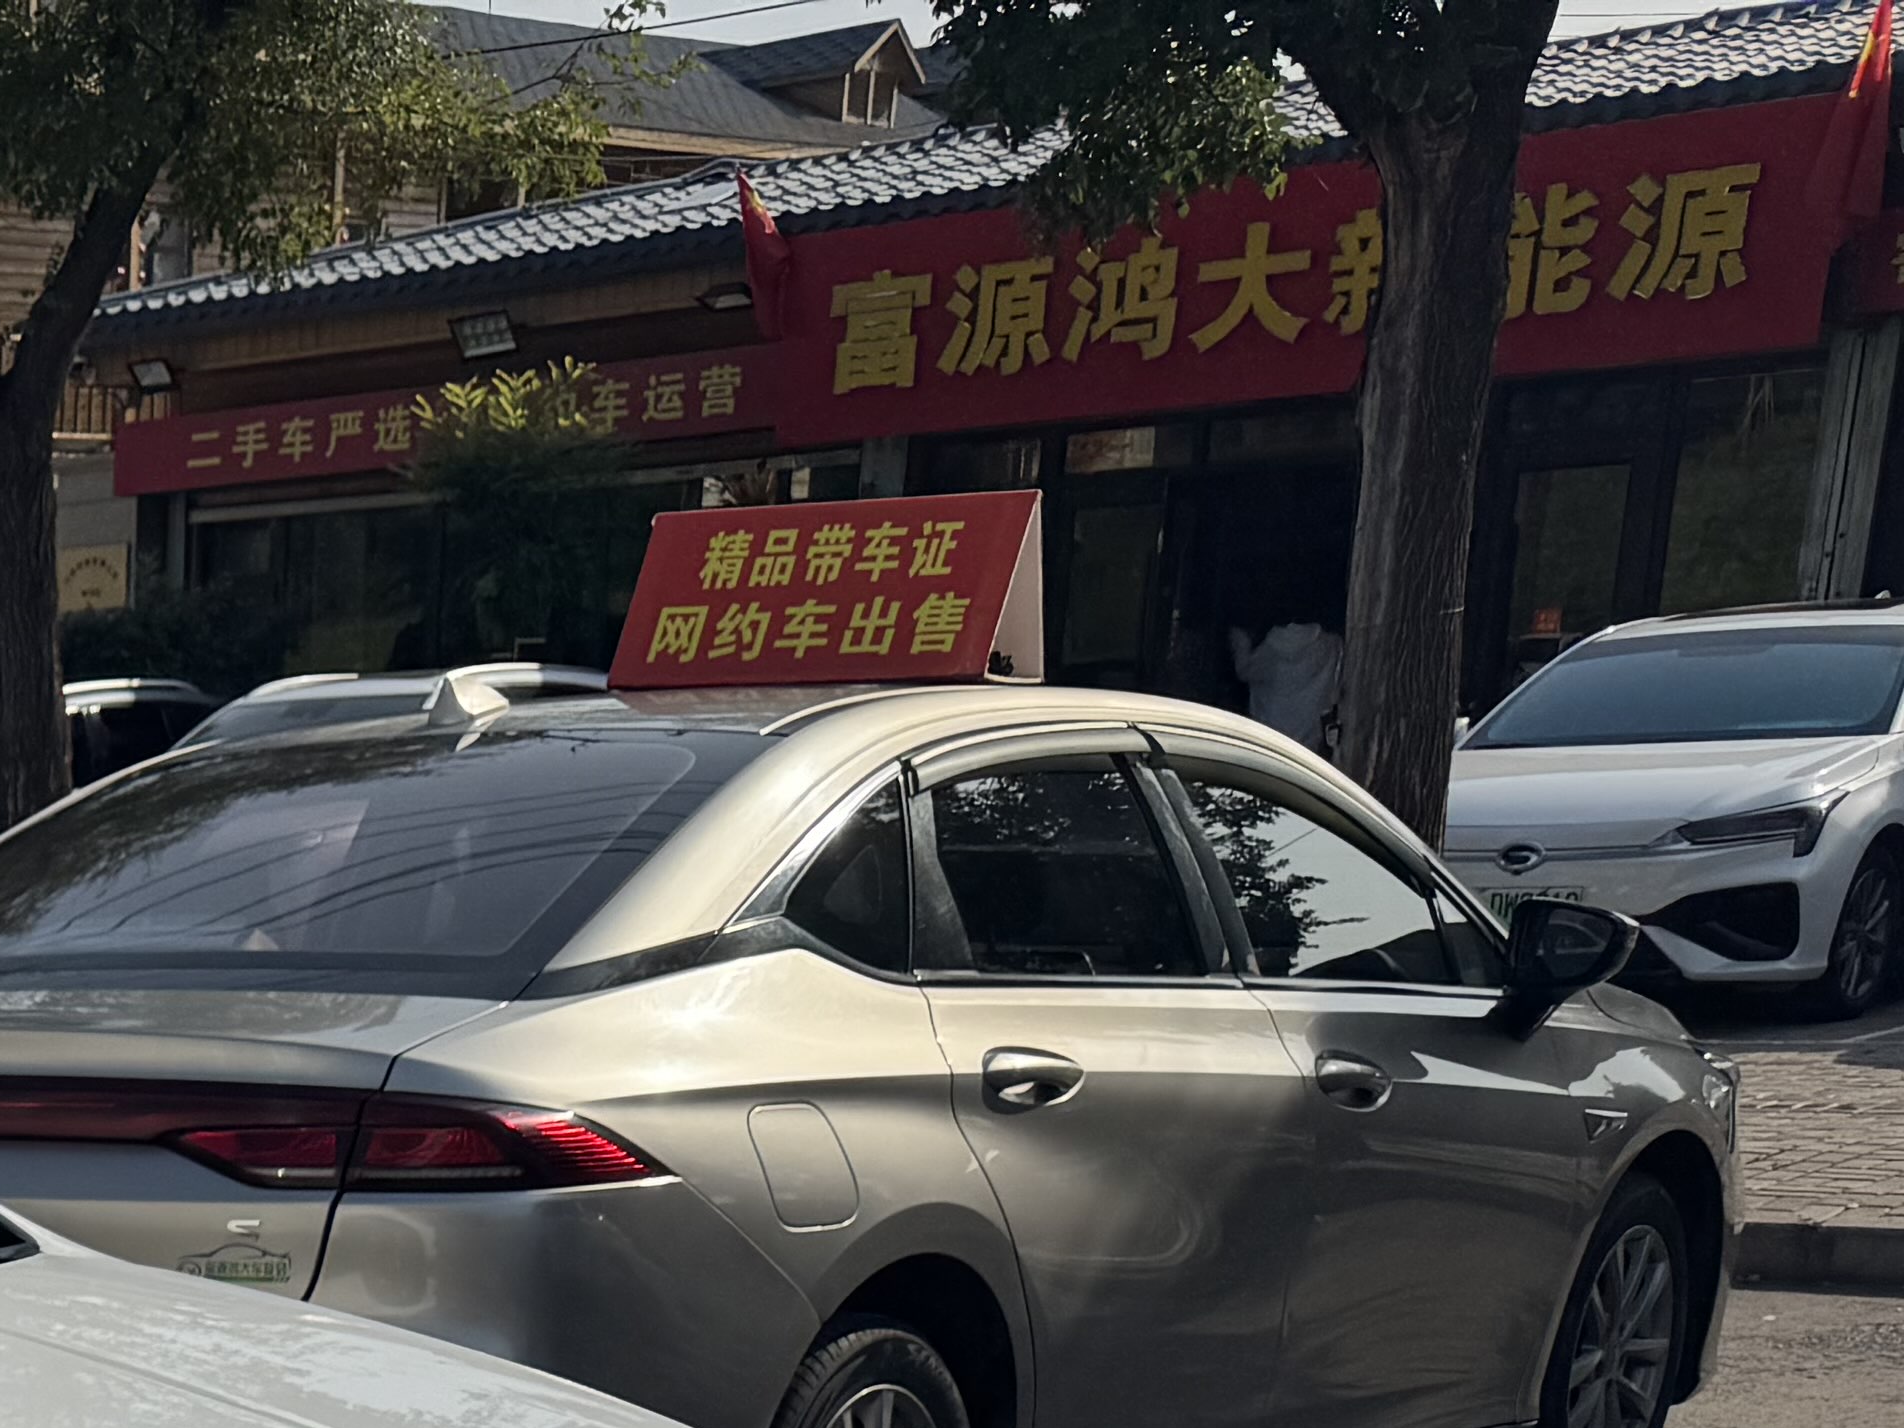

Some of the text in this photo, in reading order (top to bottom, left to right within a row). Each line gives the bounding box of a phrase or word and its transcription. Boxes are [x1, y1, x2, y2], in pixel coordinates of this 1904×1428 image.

[700, 520, 965, 591] 精品带车证
[646, 591, 972, 664] 网约车出售
